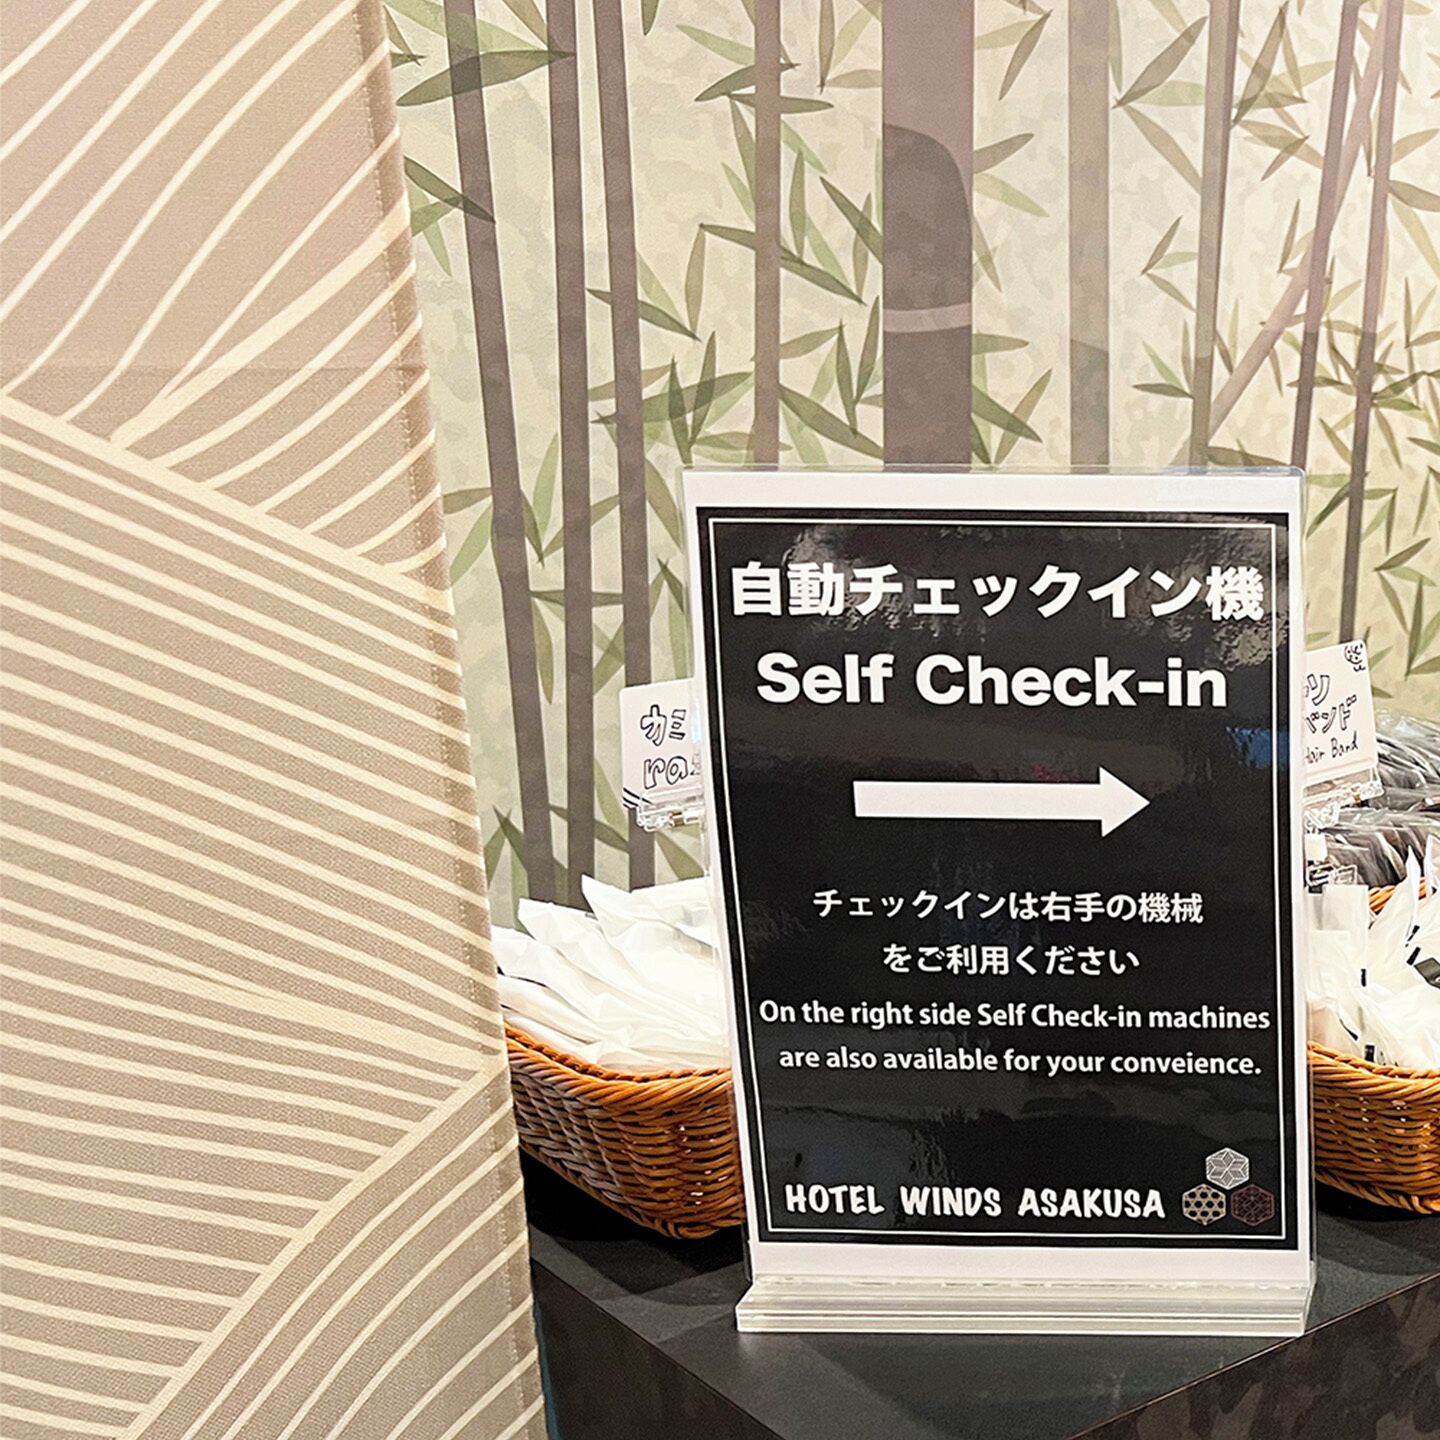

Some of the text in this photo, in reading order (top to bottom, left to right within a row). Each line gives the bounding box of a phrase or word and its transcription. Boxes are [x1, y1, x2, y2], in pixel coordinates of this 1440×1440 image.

[732, 561, 1264, 621] 自動チェックイン機
[757, 652, 1226, 707] Self Check-in
[812, 889, 1204, 924] チェックインは右手の機械
[882, 943, 1140, 976] をご利用ください
[759, 999, 1271, 1030] On the right side Self Check-in machines
[779, 1046, 1262, 1077] are also available for your conveience.
[785, 1183, 1166, 1219] HOTEL WINDS ASAKUSA
